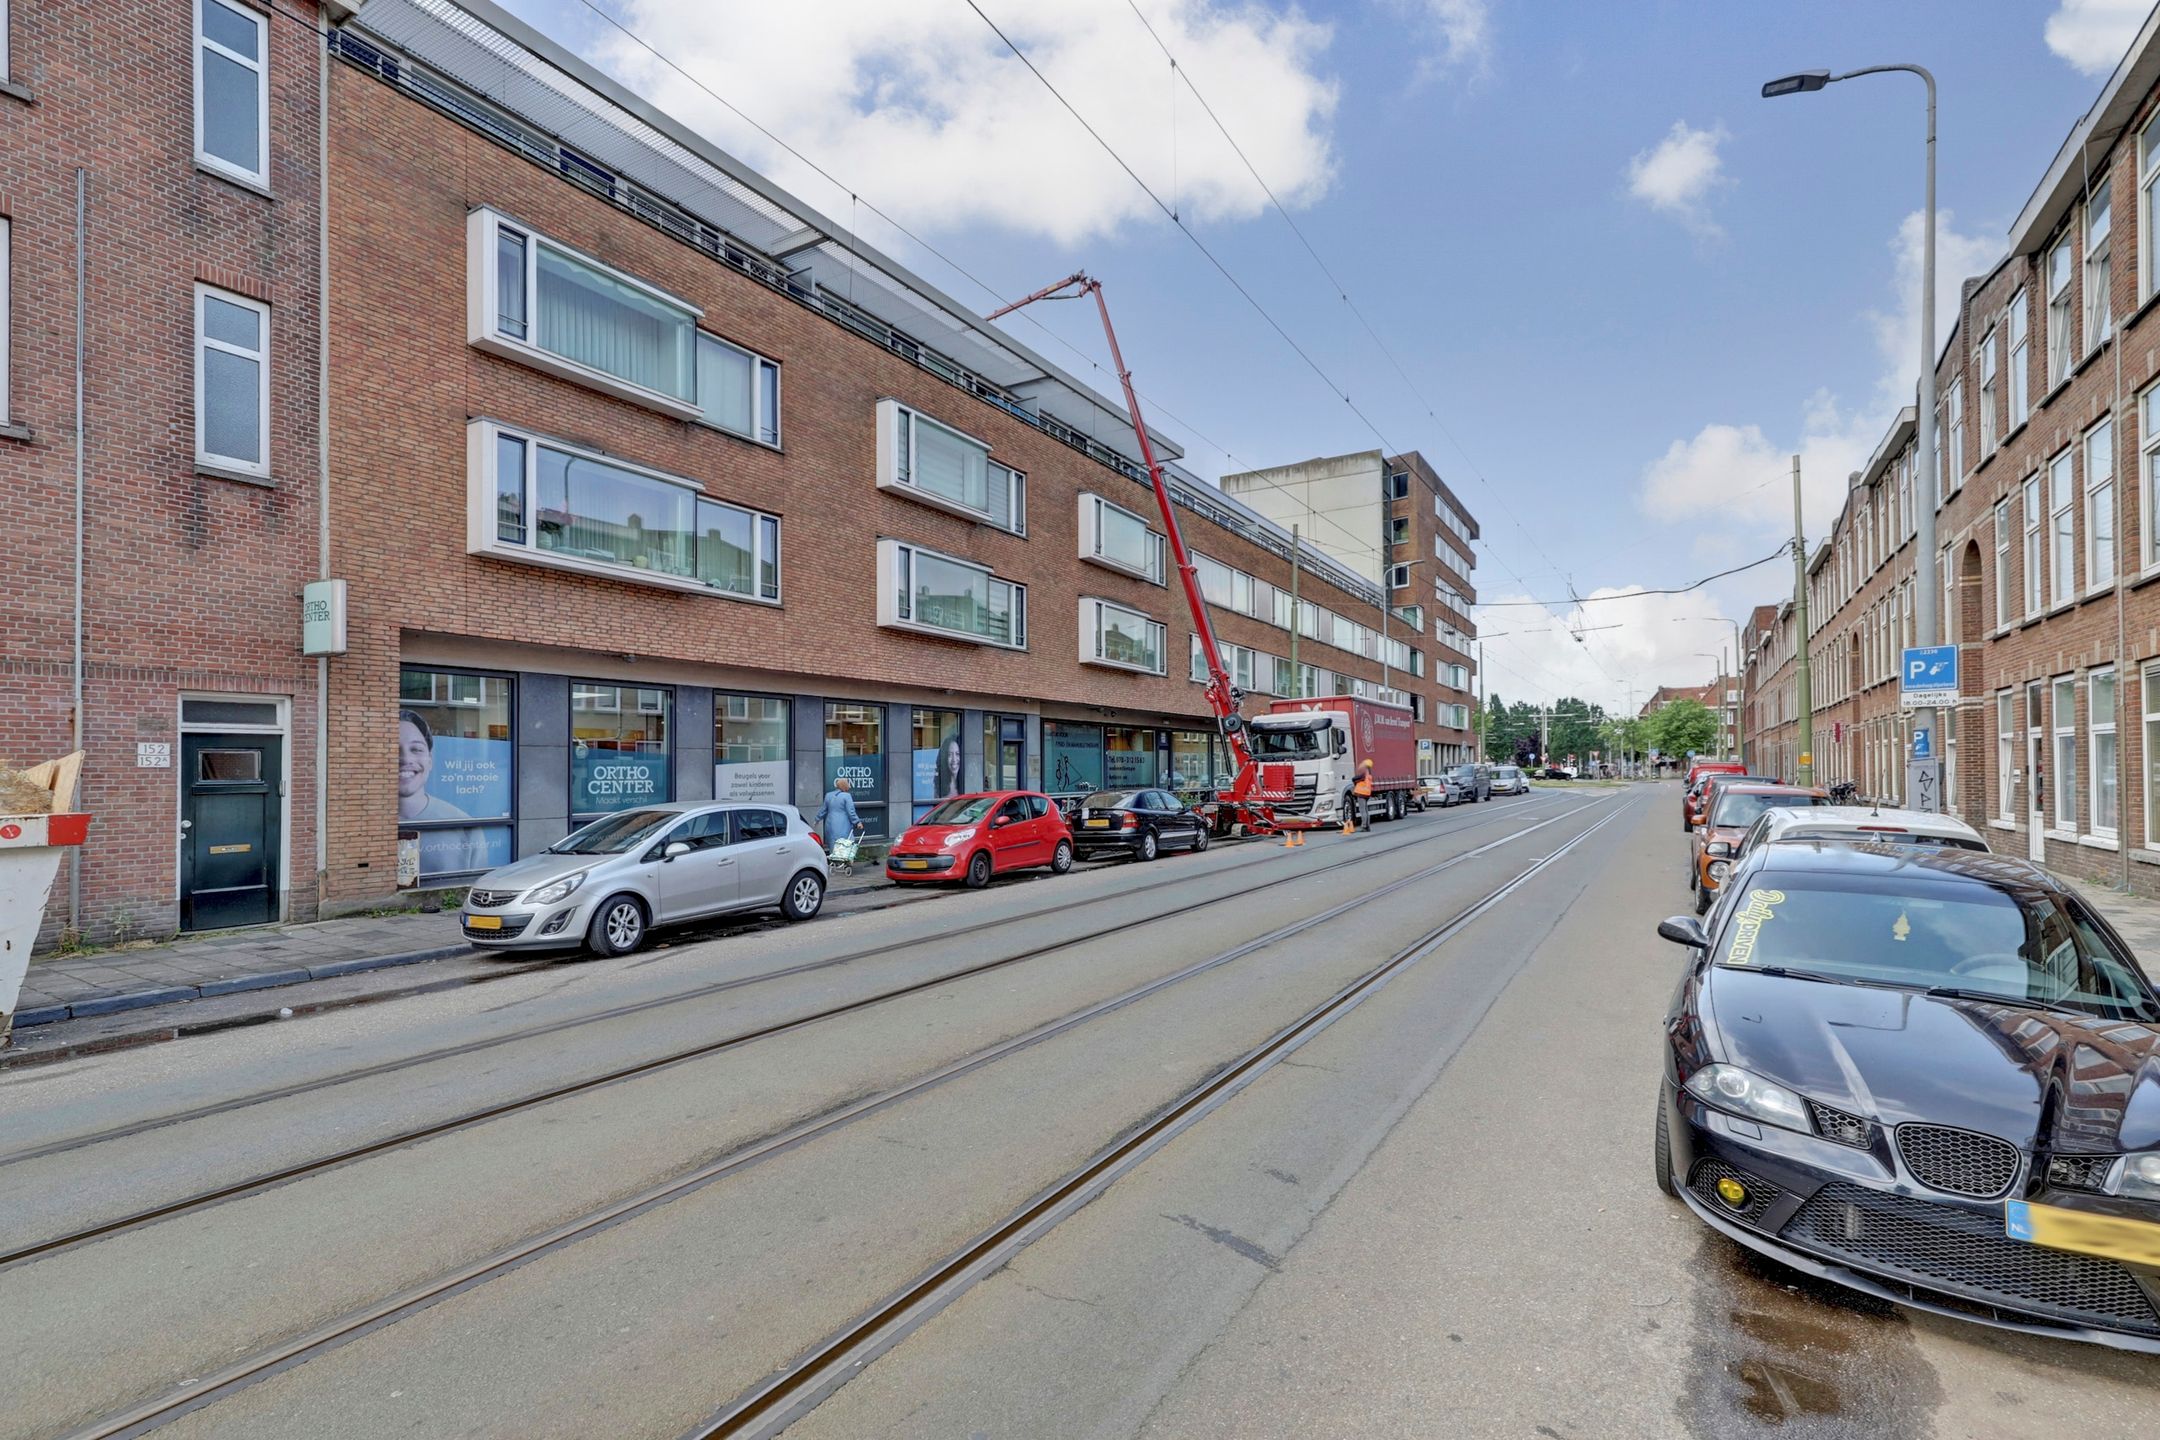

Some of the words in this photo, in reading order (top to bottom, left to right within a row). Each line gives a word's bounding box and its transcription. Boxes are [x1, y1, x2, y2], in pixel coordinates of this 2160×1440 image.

[1910, 661, 1926, 679] P
[1914, 731, 1924, 743] P
[143, 744, 165, 754] 152
[444, 760, 462, 769] Wil
[463, 760, 474, 771] jij
[476, 760, 496, 769] ook
[594, 766, 649, 780] ORTHO
[837, 766, 872, 777] ORTHO
[441, 773, 464, 782] zo'n
[466, 773, 499, 782] mooie
[456, 785, 485, 794] lach?
[588, 780, 654, 794] CENTER
[1727, 921, 1761, 964] DRIVEN
